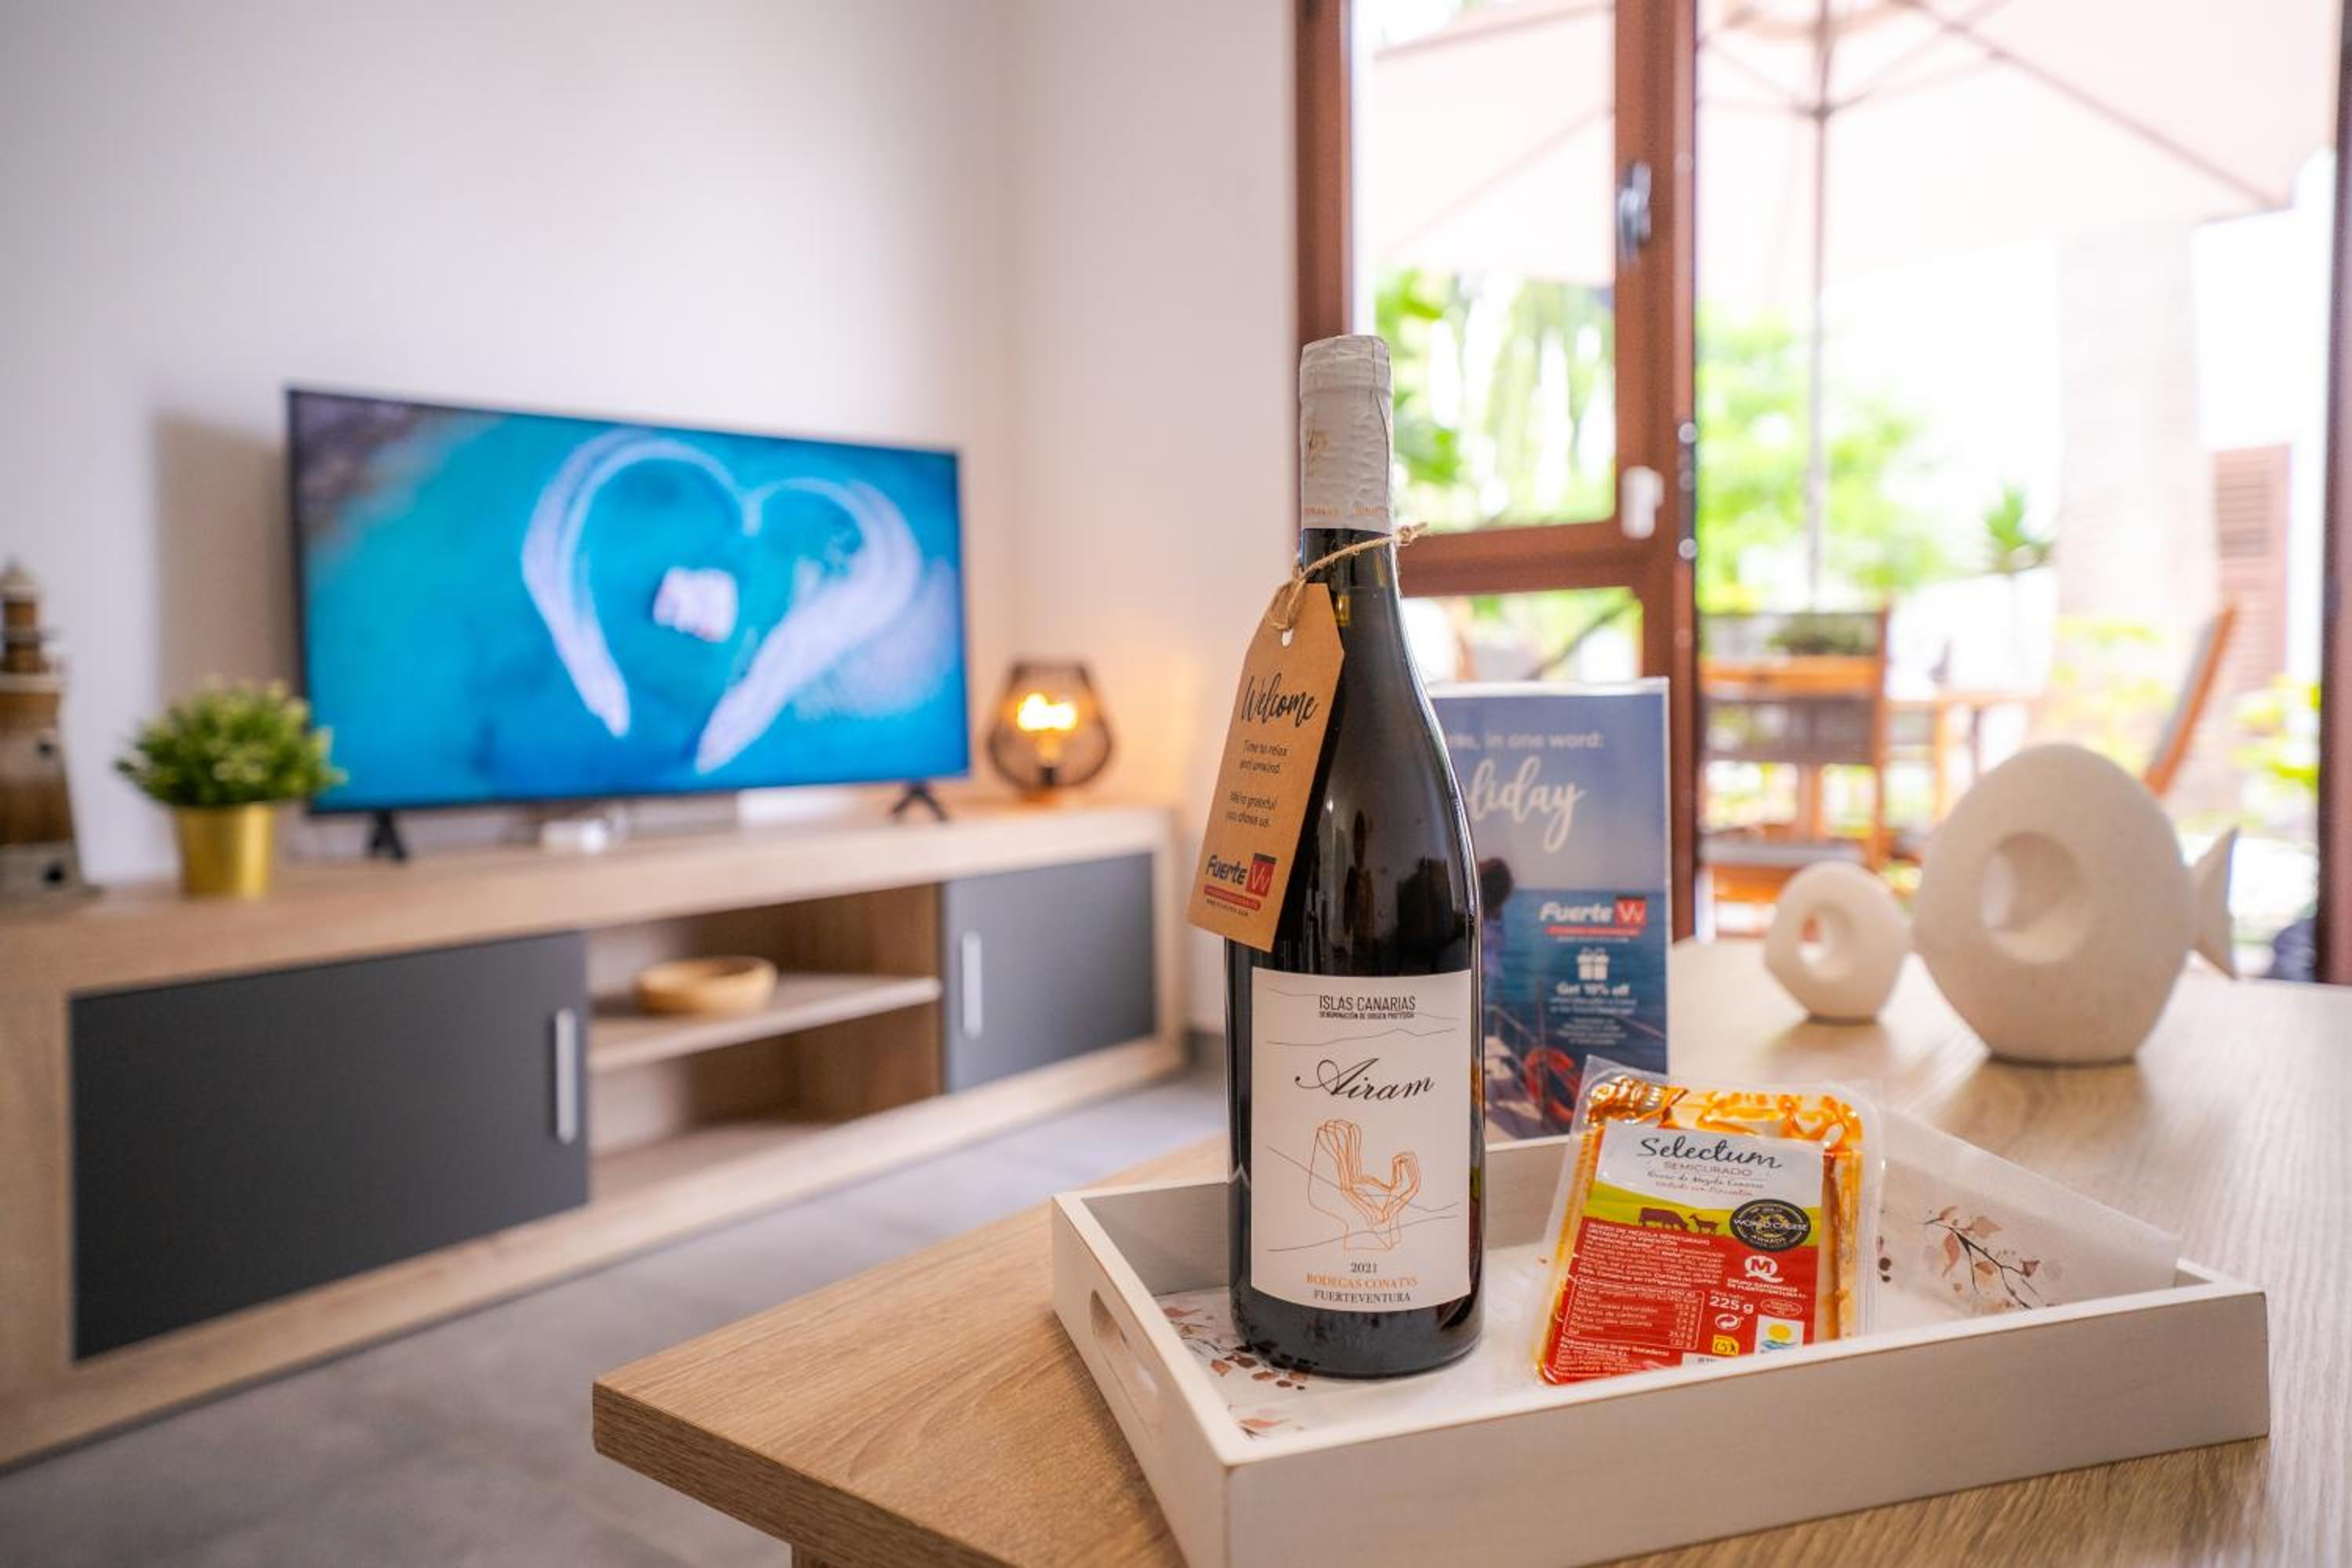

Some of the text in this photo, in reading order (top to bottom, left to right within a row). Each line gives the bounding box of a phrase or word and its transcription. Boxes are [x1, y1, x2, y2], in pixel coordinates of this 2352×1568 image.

[1241, 673, 1318, 728] Welcome
[1507, 735, 1544, 749] one
[1204, 853, 1248, 886] Fuerte
[1540, 902, 1613, 924] Fuerte
[1319, 994, 1416, 1012] ISLAS CANARIAS
[1294, 1058, 1435, 1100] Airam
[1637, 1134, 1782, 1169] Selectum
[1663, 1161, 1753, 1177] SEMICURADO
[1349, 1262, 1378, 1273] 2021
[1305, 1272, 1362, 1289] BODEGAS
[1314, 1290, 1412, 1304] FUERTEVENTURA
[1709, 1295, 1740, 1311] 225
[1742, 1303, 1755, 1315] g
